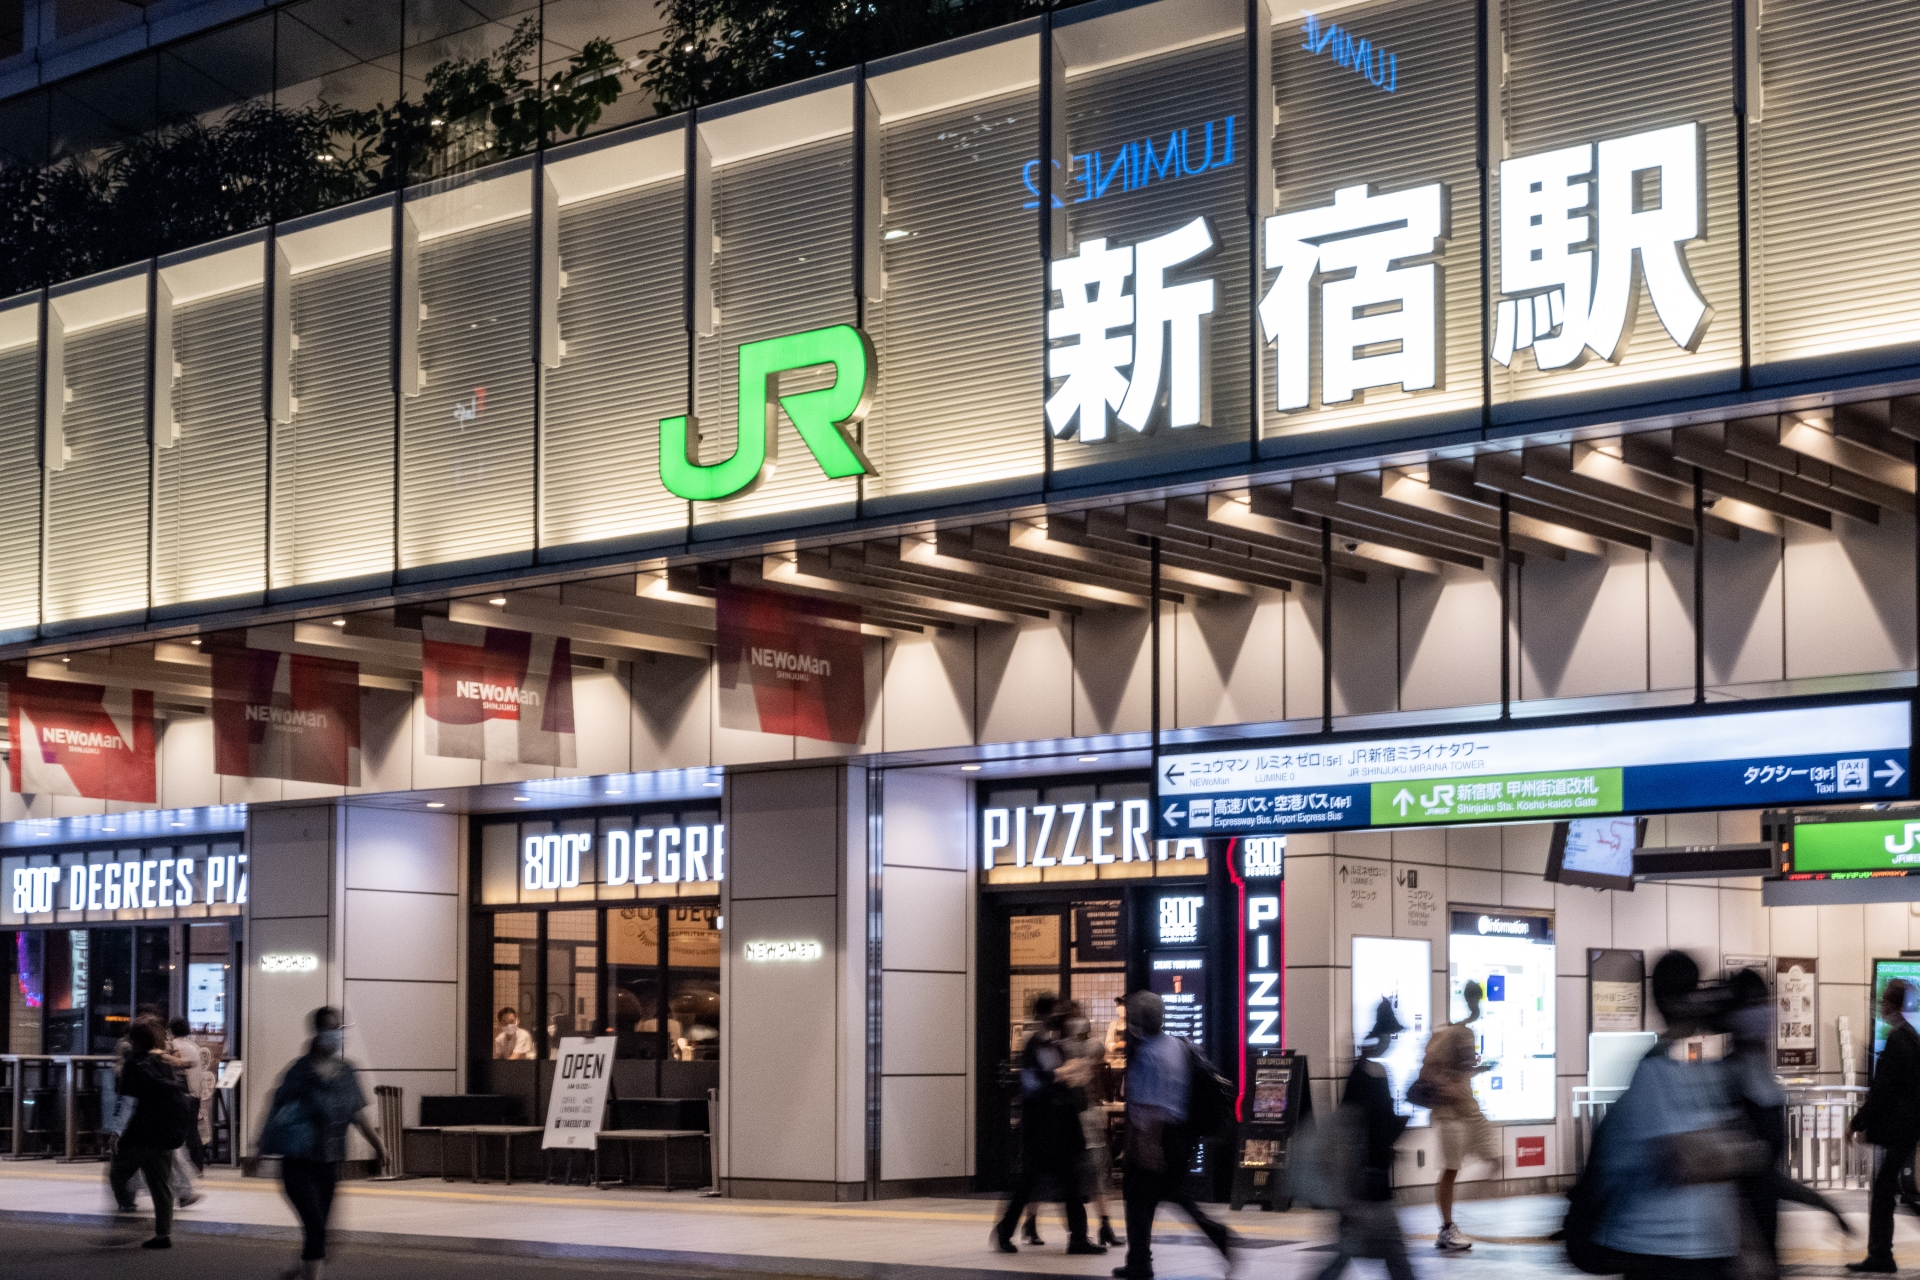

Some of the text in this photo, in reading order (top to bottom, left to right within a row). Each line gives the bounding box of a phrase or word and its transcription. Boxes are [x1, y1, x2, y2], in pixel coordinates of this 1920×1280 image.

[659, 121, 1710, 502] JR 新宿駅
[751, 647, 831, 677] NEWoMan
[456, 680, 540, 707] NEWoMan
[245, 704, 327, 730] NEWoMan
[43, 727, 122, 751] NEWoMan
[1189, 758, 1250, 774] ニュウマン
[1189, 777, 1230, 787] NEWoMan
[1255, 773, 1287, 783] LUMINE
[1361, 764, 1407, 777] SHINJUKU
[1409, 762, 1448, 774] MIRAINA
[1450, 759, 1485, 770] TOWER
[1420, 784, 1456, 808] JR
[1456, 776, 1599, 801] 新宿駅 甲州街道改札
[1814, 781, 1837, 794] Taxi
[1457, 802, 1495, 815] Shinjuku
[1497, 800, 1514, 812] Sta.
[1574, 797, 1598, 807] Gate
[1214, 817, 1255, 829] Expressway
[1272, 813, 1297, 826] Airport
[1298, 811, 1326, 824] Express
[1327, 811, 1343, 821] Bus
[70, 858, 194, 911] DEGREES
[1248, 896, 1280, 1054] PIZZ
[562, 1054, 605, 1079] OPEN
